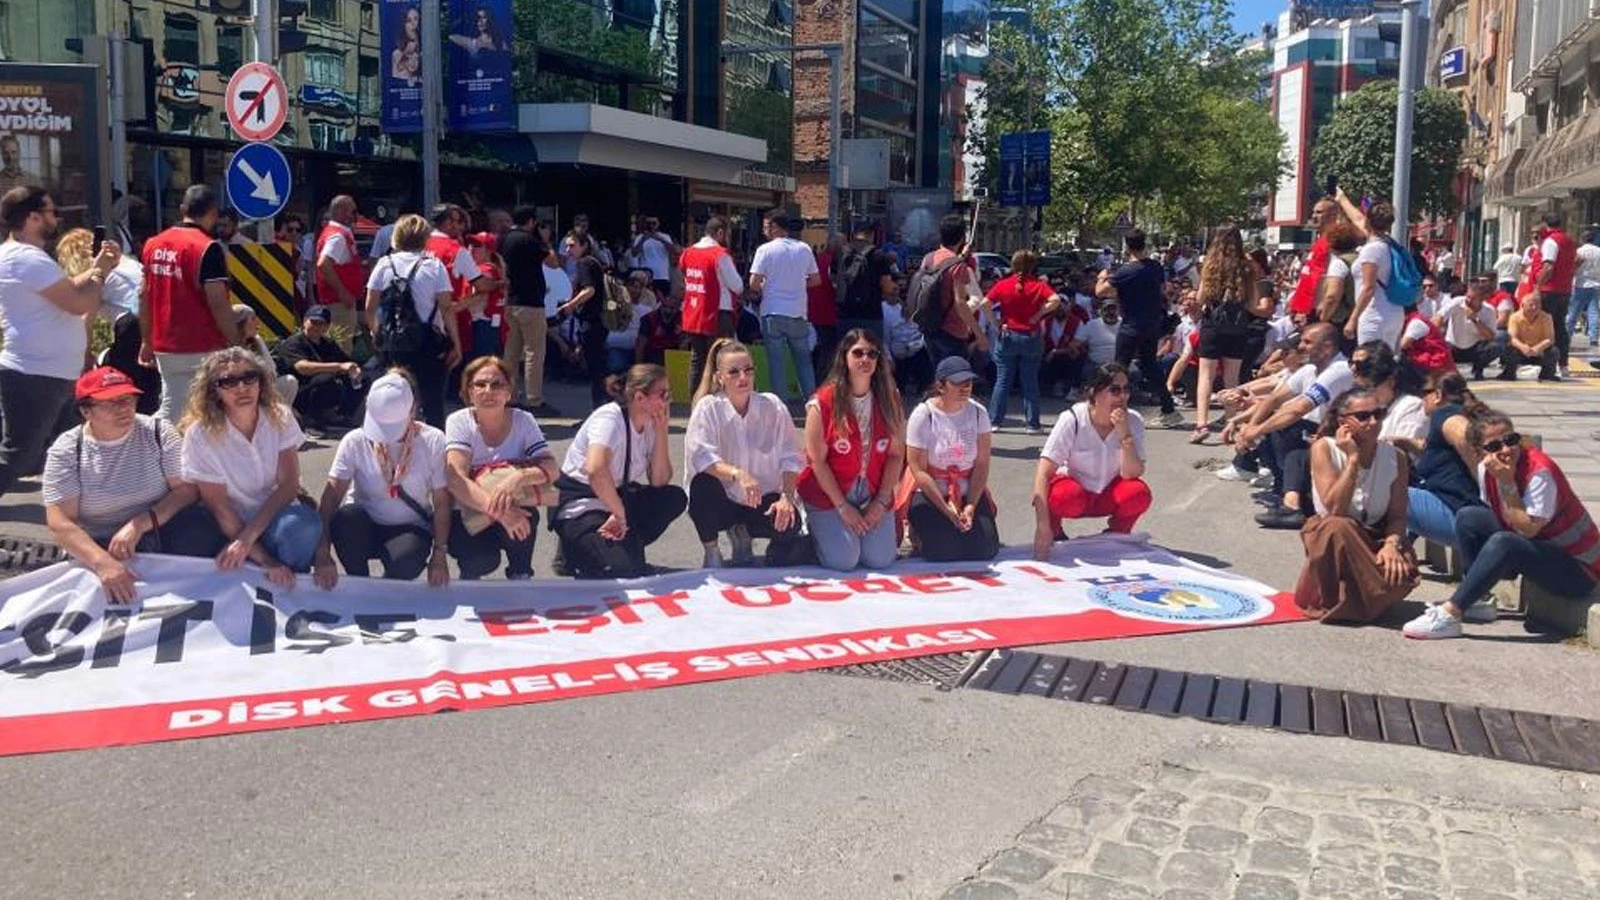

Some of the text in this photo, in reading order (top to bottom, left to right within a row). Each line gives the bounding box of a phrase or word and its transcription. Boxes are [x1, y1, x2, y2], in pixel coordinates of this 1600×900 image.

[0, 597, 214, 679] ŞİT
[475, 591, 690, 636] EŞİT
[688, 628, 996, 672] SENDİKASI
